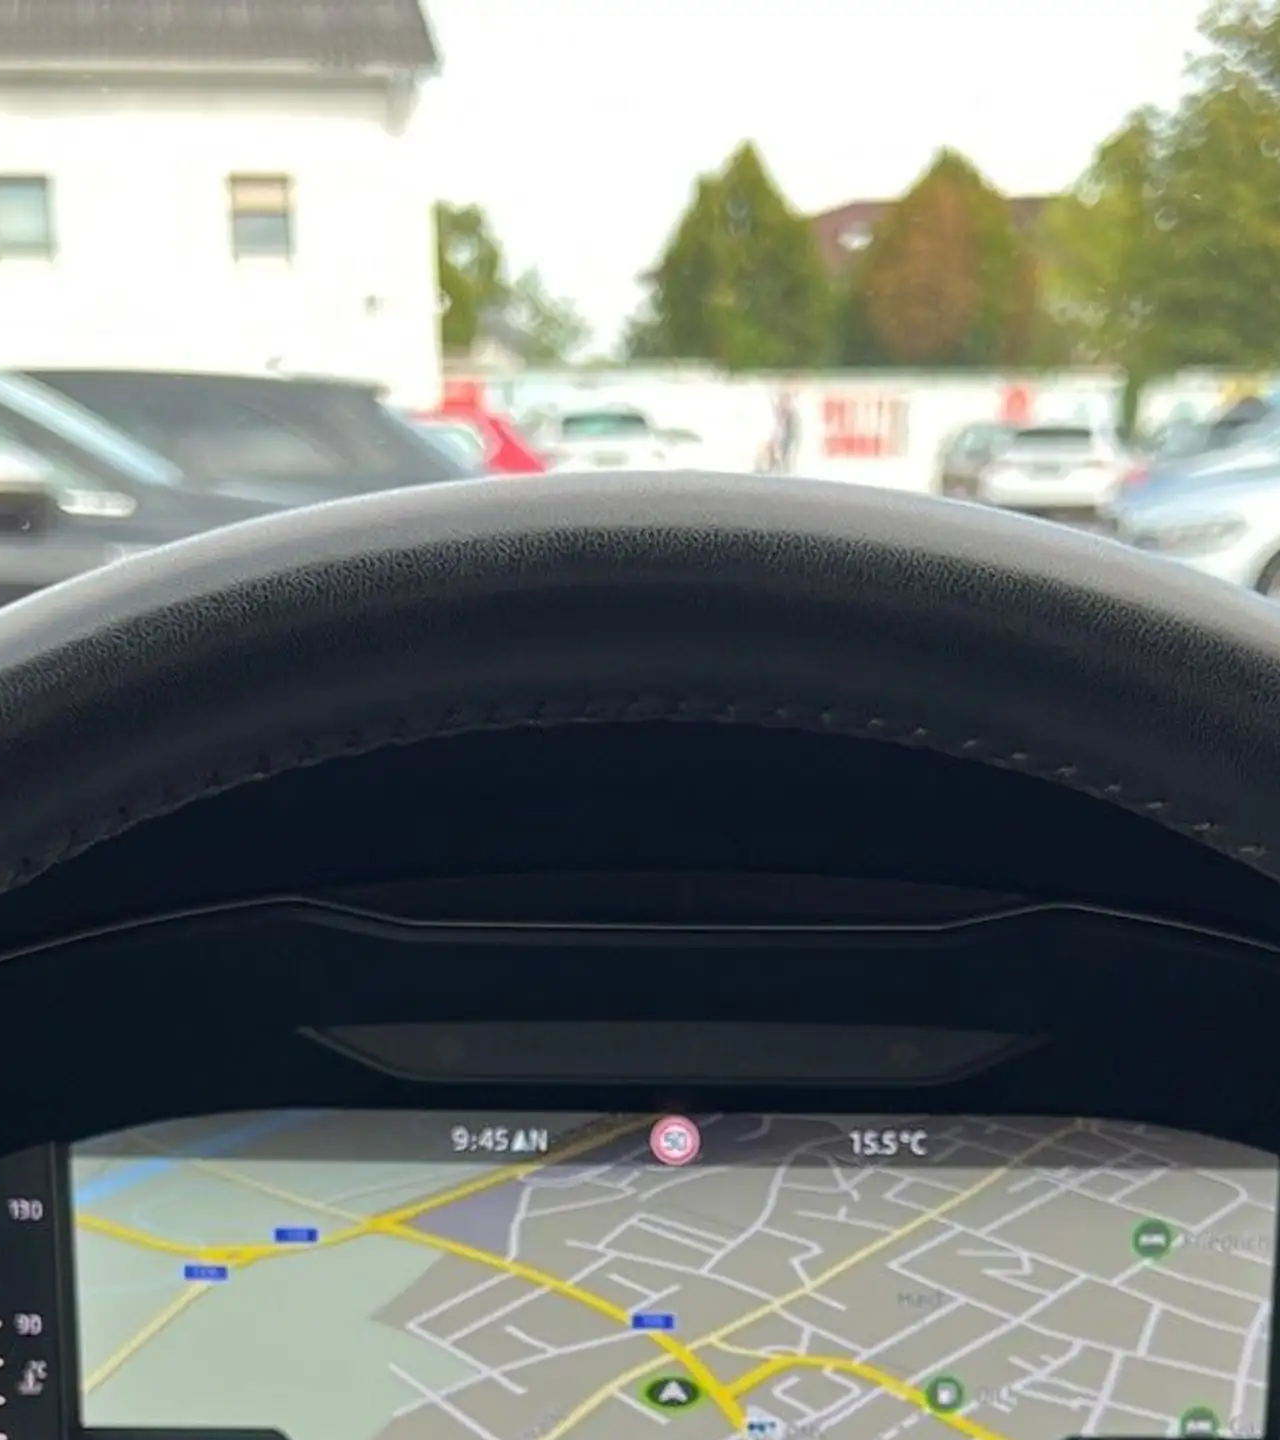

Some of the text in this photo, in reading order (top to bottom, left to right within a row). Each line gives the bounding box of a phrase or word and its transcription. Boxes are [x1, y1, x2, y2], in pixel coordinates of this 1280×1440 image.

[450, 1124, 509, 1152] 9:45
[9, 1199, 44, 1221] 130
[14, 1313, 43, 1336] 90
